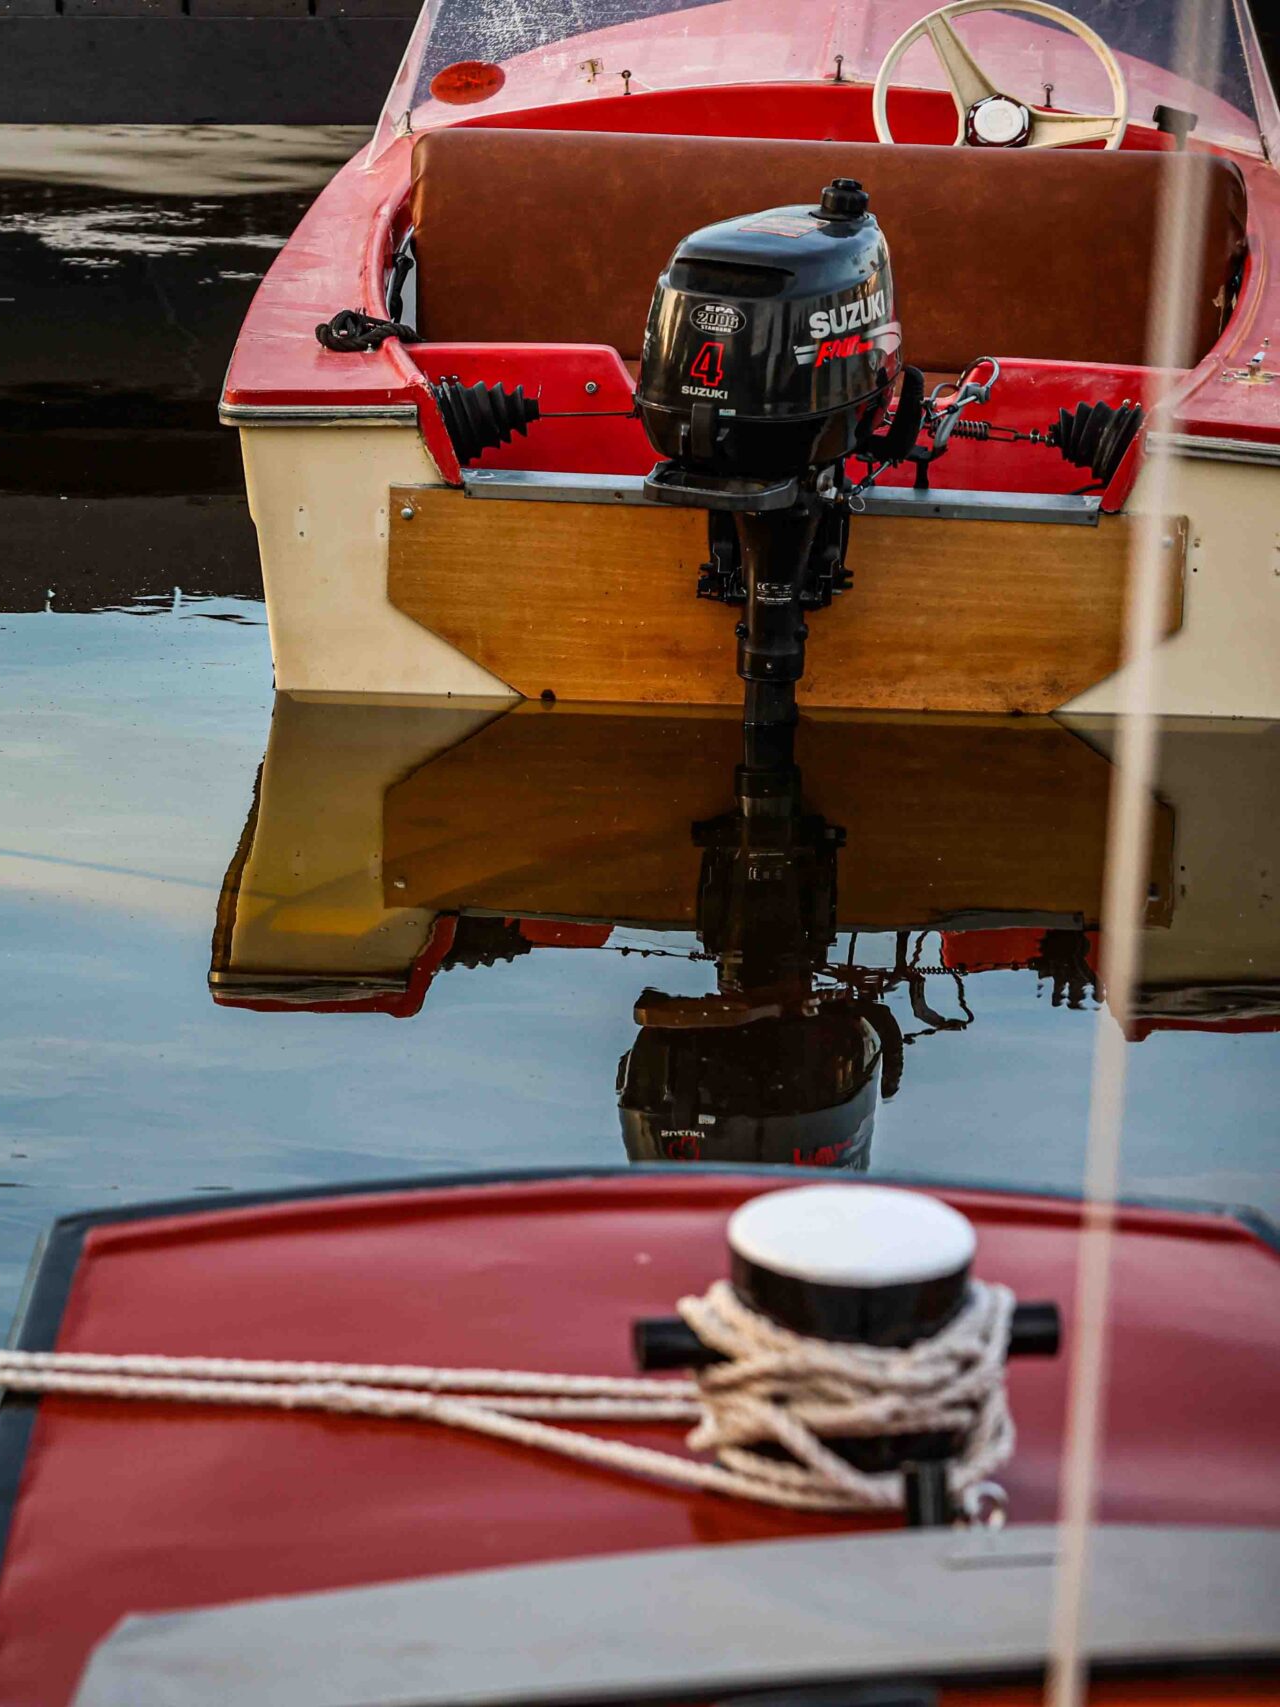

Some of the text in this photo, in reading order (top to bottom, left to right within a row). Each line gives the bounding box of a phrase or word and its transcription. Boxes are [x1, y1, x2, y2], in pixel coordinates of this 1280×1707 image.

[705, 305, 735, 315] EPA
[809, 290, 886, 339] SUZUKI
[696, 311, 739, 329] 2006
[690, 342, 725, 387] 4
[681, 385, 729, 400] SUZUKI
